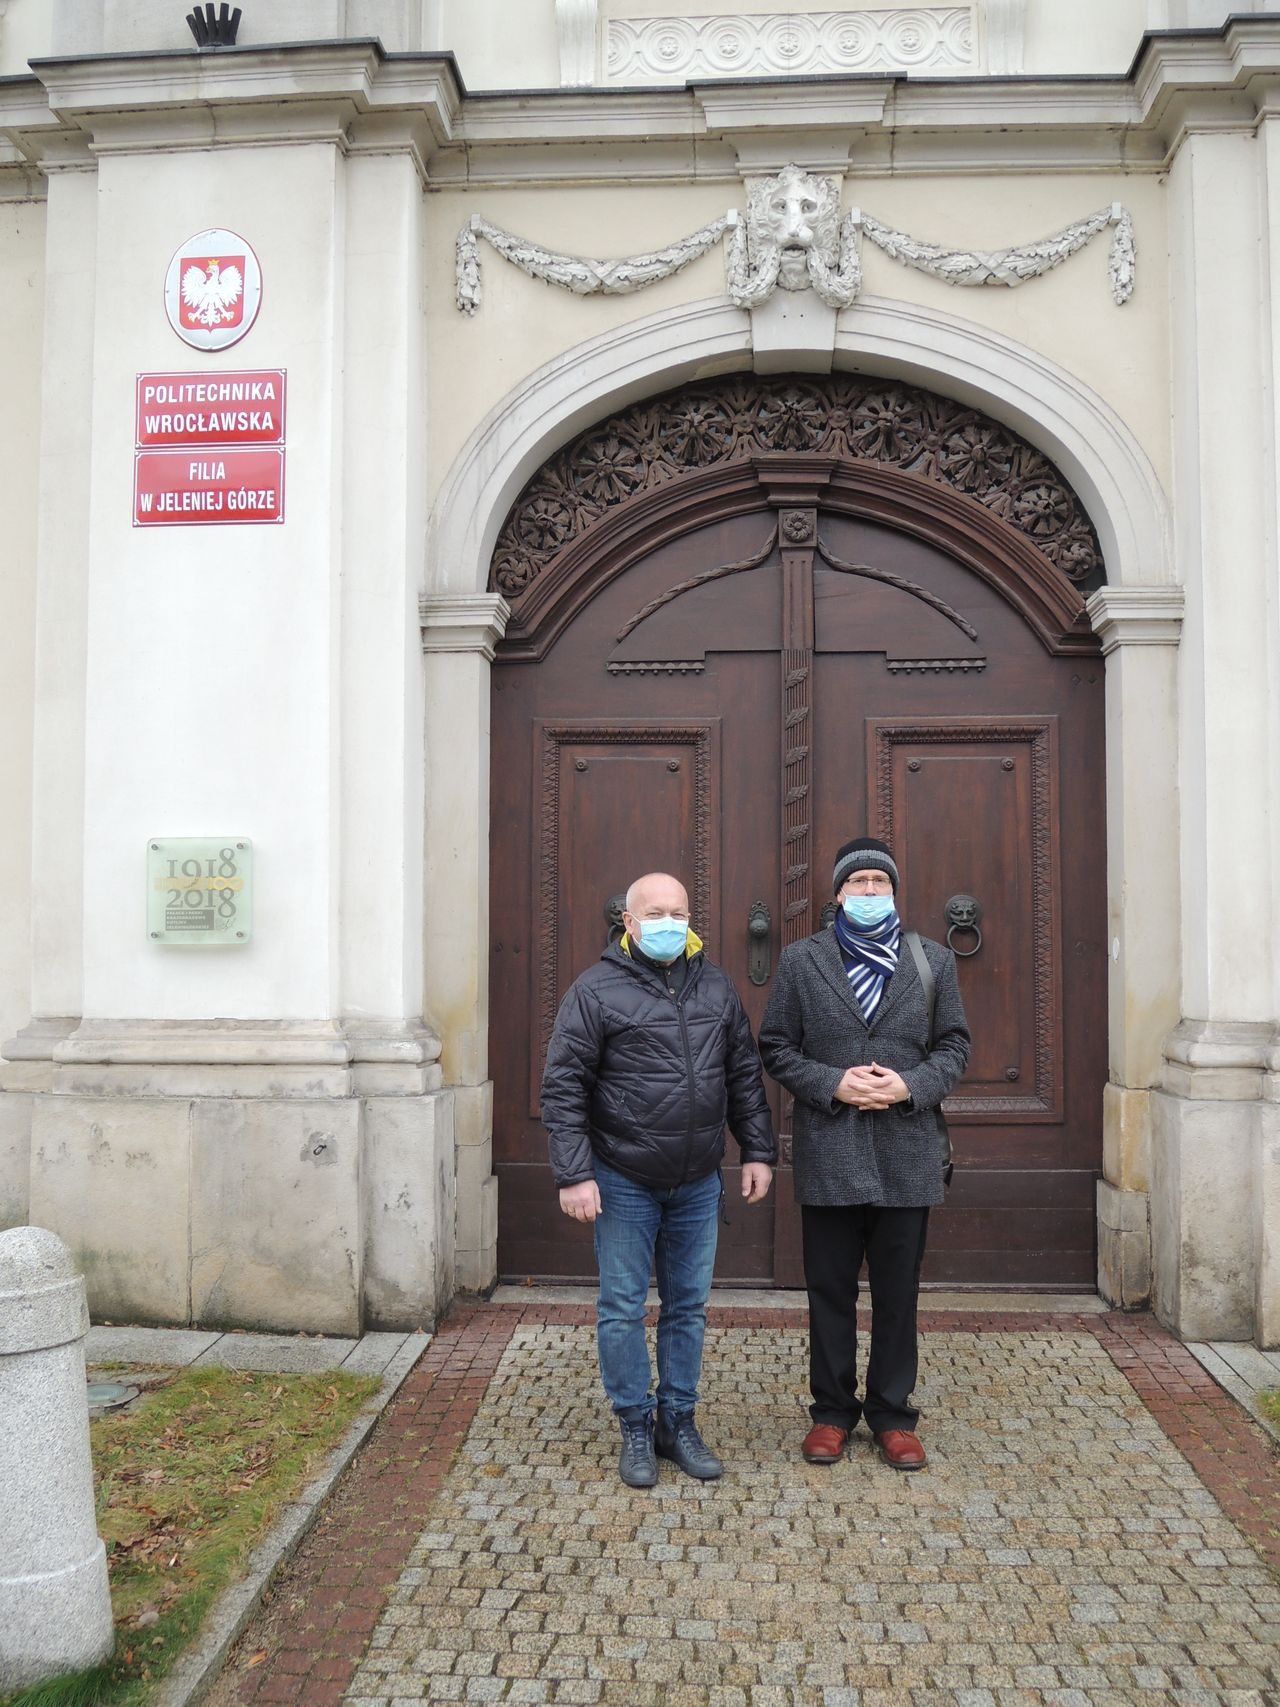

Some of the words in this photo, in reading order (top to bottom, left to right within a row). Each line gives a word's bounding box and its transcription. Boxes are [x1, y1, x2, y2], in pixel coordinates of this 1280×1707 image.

[144, 382, 276, 404] POLITECHNIKA
[144, 411, 274, 433] WROCŁAWSKA
[189, 461, 226, 480] FILIA
[140, 493, 153, 512] W
[156, 490, 223, 512] JELENIEJ
[227, 486, 275, 510] GÓRZE
[165, 847, 237, 888] 1918
[165, 887, 237, 918] 2018
